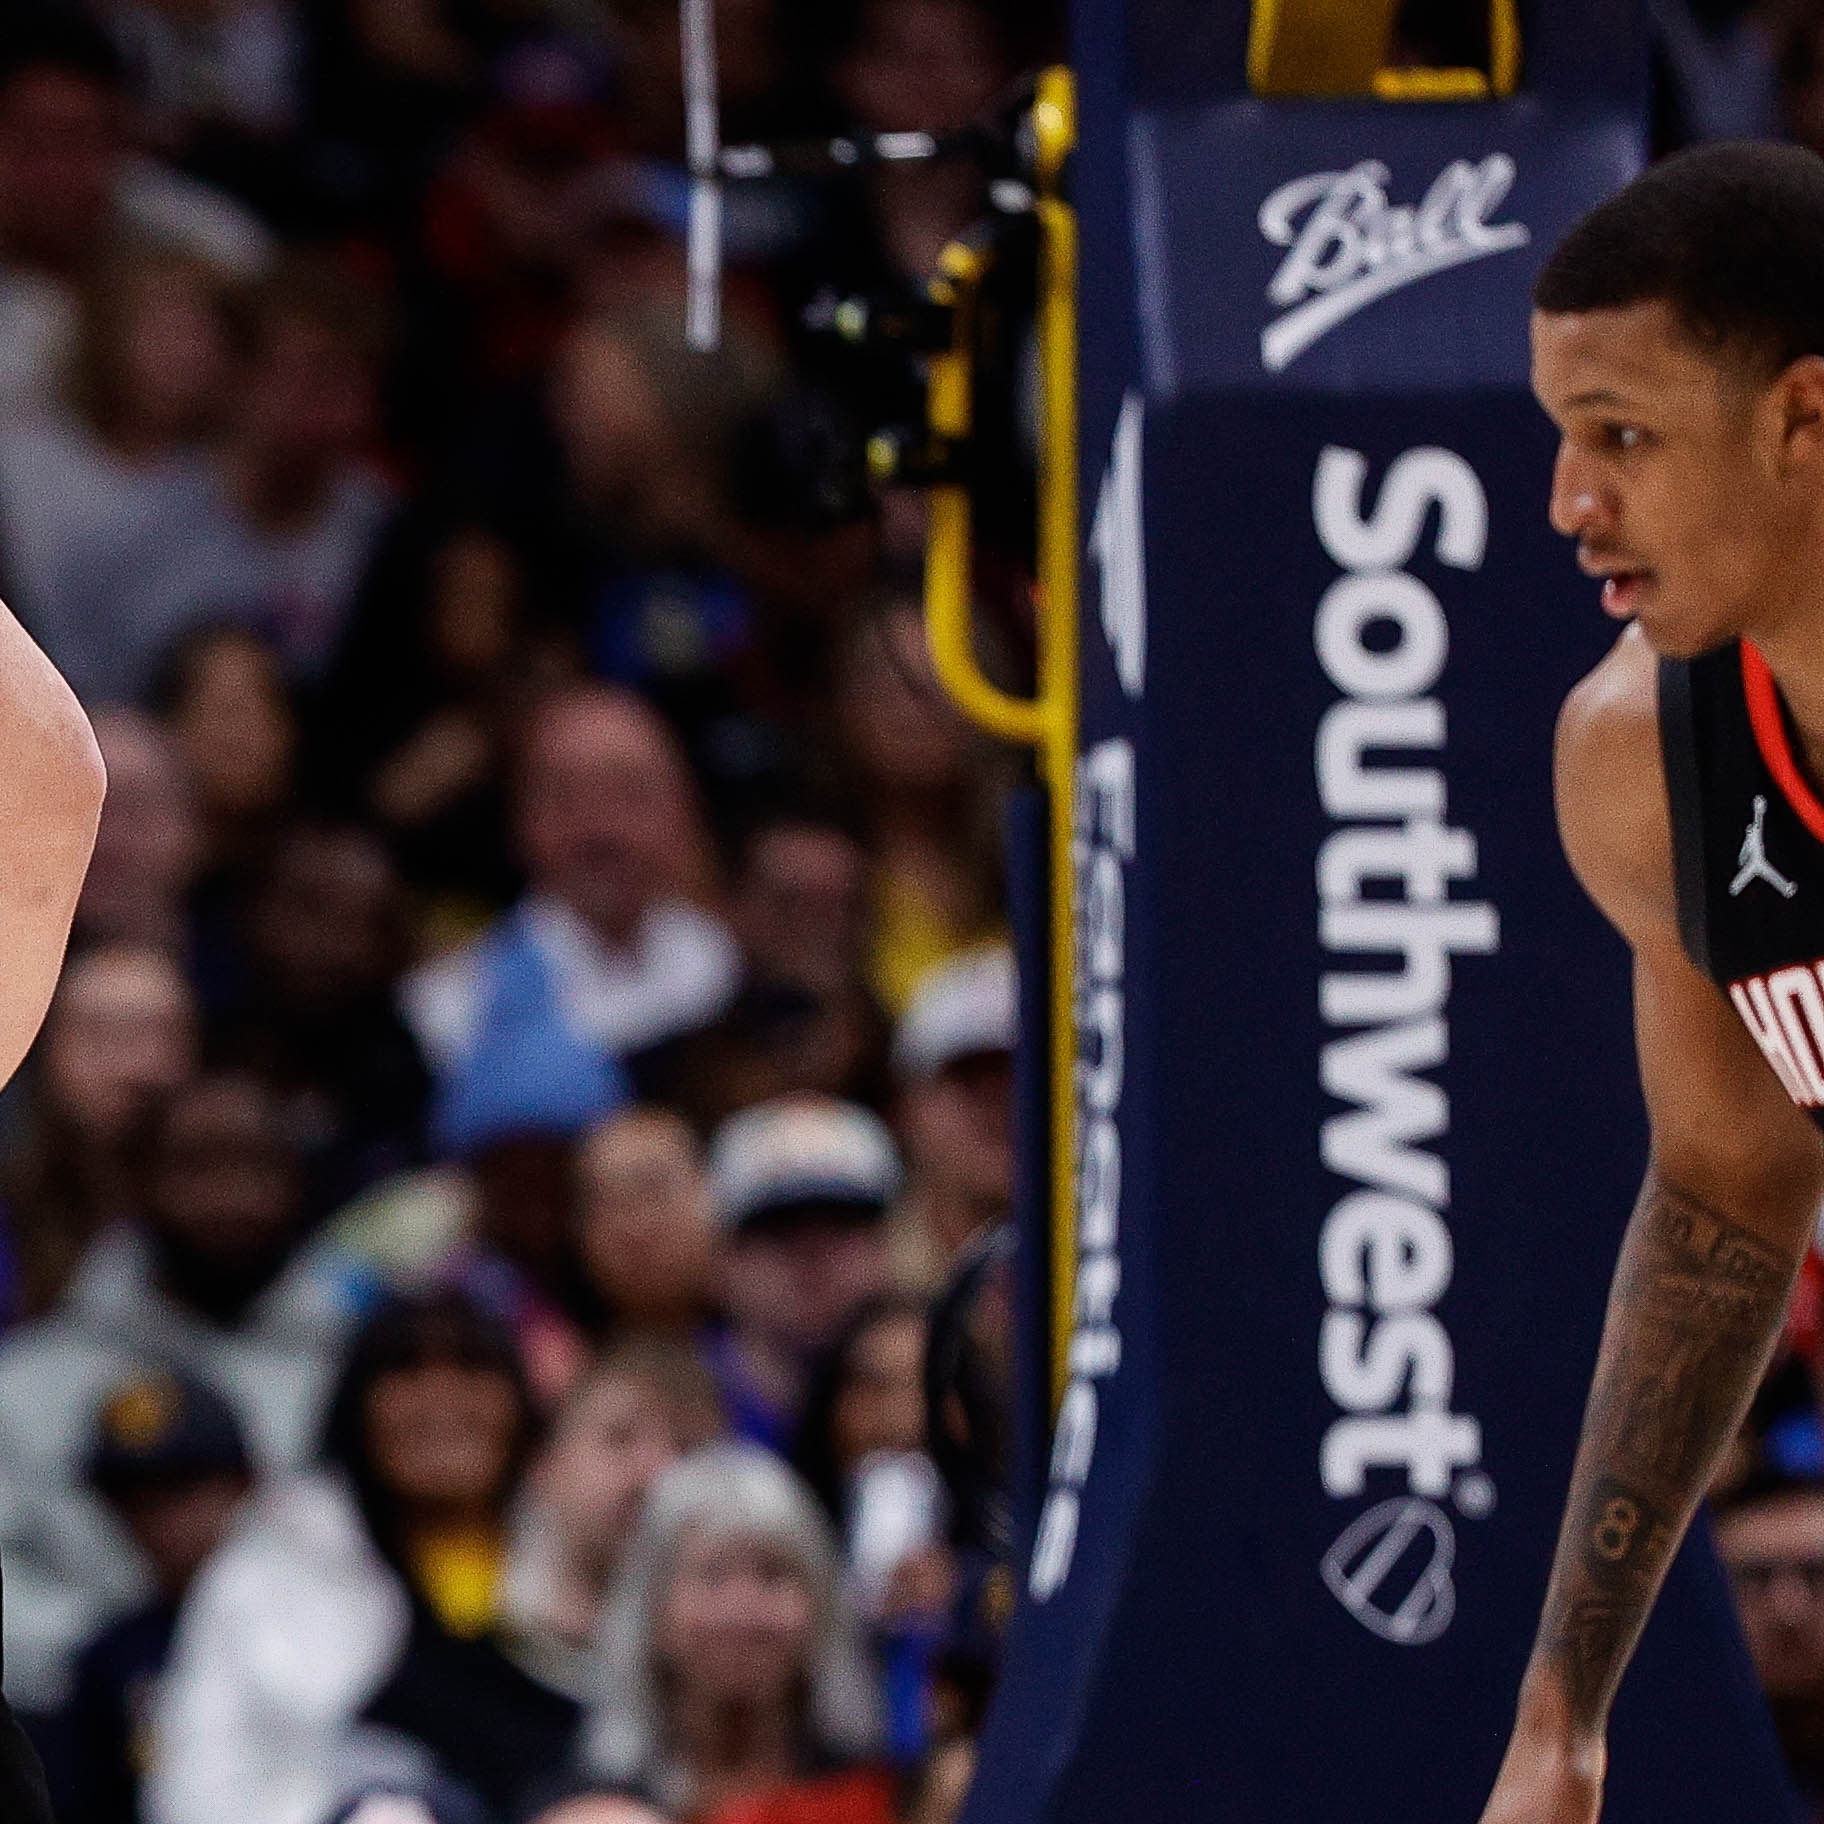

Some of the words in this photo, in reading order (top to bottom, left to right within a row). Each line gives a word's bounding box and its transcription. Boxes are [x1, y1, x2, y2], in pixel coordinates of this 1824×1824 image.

[1257, 152, 1530, 372] Ball
[1312, 443, 1502, 1500] Southwest
[1727, 958, 1824, 1108] HO
